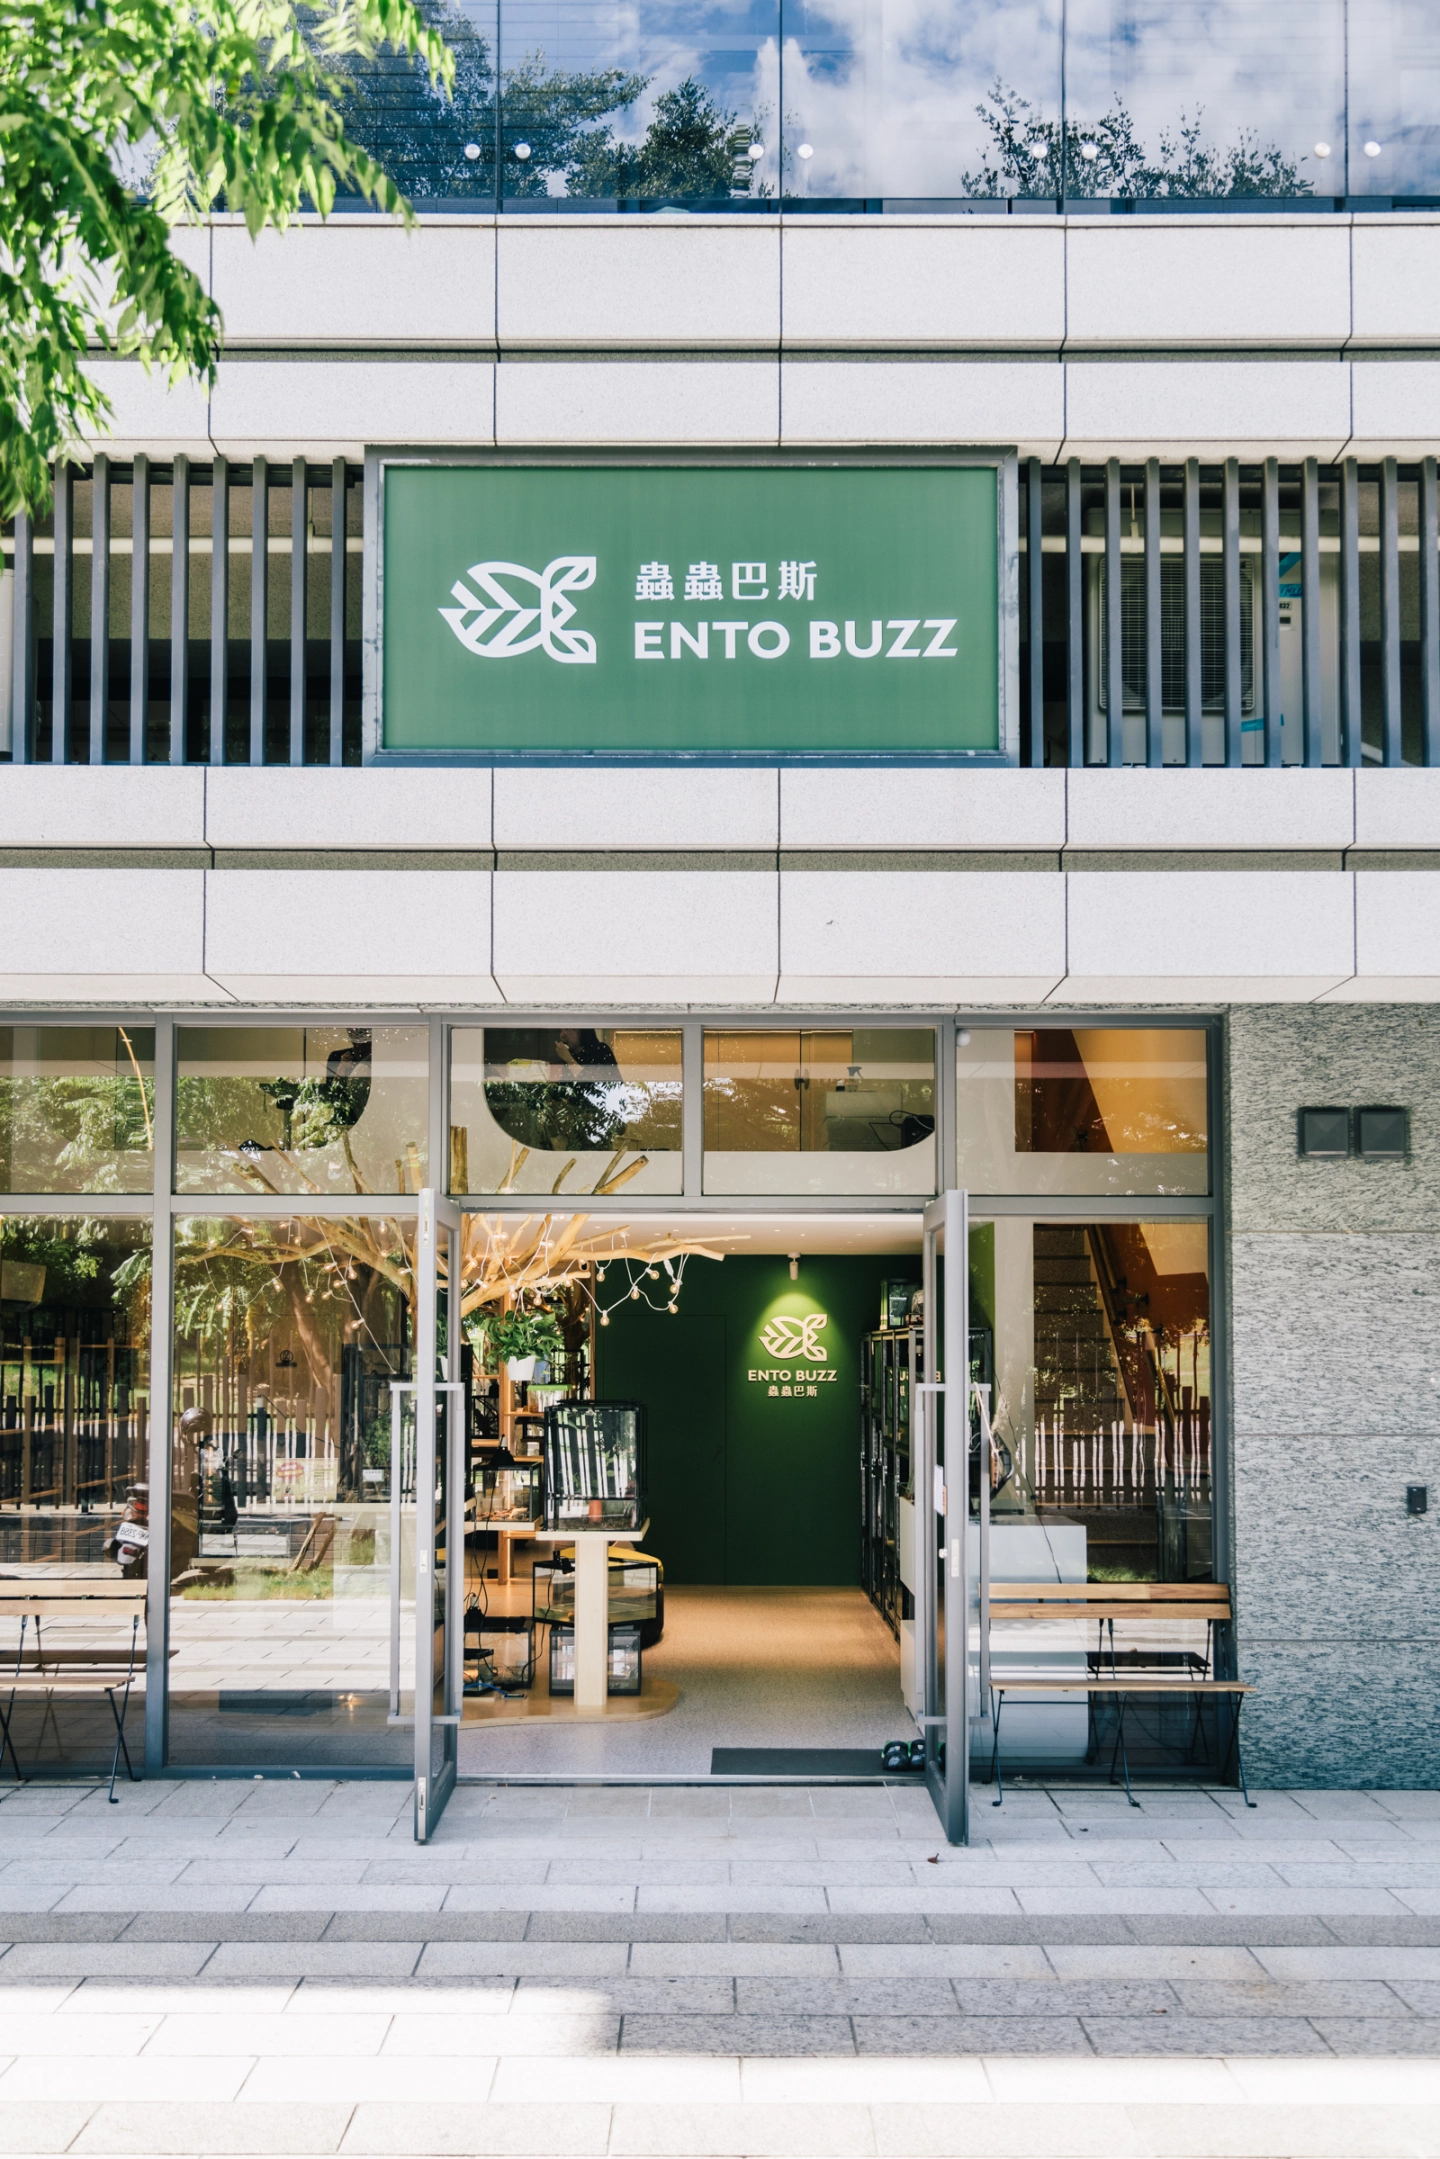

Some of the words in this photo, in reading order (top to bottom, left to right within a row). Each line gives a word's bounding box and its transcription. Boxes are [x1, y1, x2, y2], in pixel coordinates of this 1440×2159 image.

[635, 561, 817, 600] 蟲蟲巴斯
[635, 622, 790, 658] ENTO
[810, 619, 957, 658] BUZZ
[749, 1370, 791, 1381] ENTO
[796, 1370, 836, 1381] BUZZ
[768, 1385, 817, 1396] 蟲蟲巴斯
